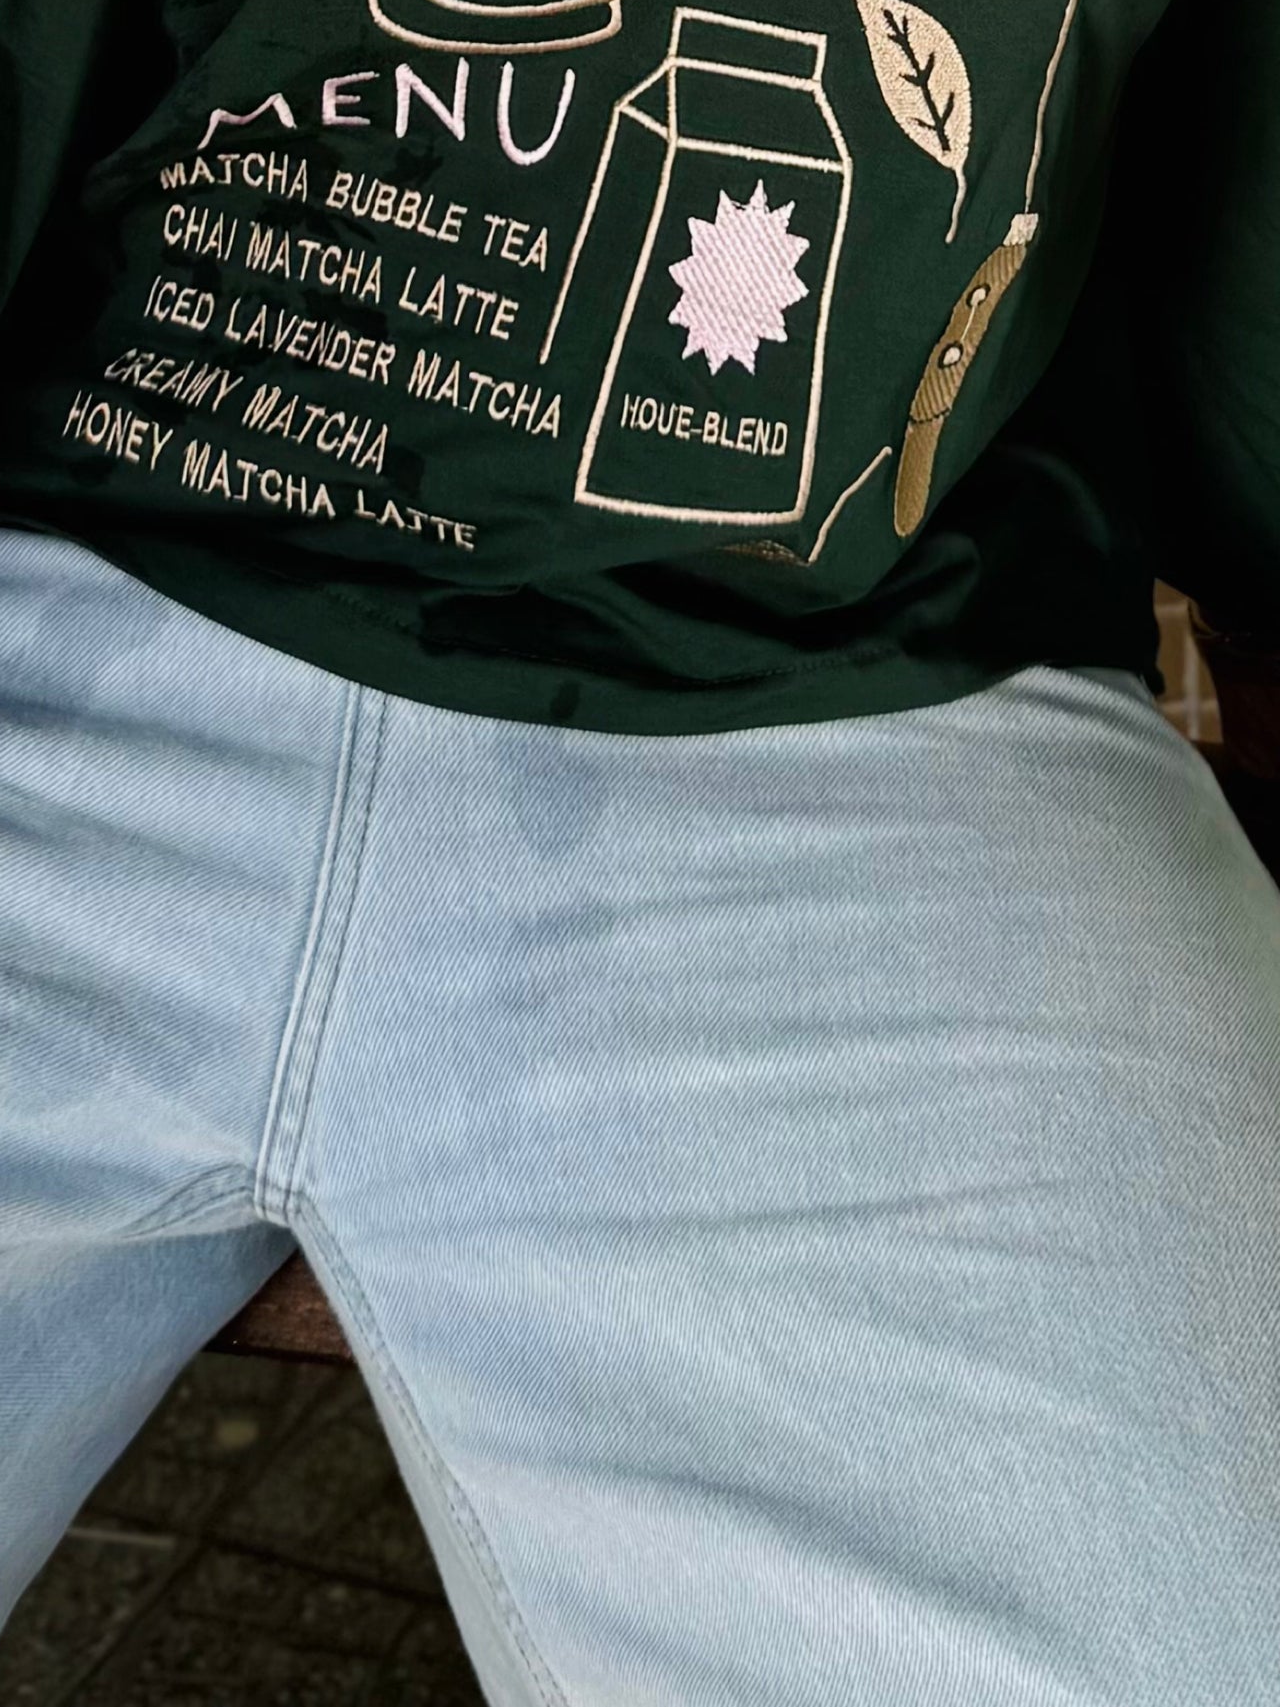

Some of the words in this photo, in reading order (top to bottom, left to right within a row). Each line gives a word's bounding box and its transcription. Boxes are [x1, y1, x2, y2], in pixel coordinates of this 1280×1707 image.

[197, 56, 576, 166] MENU
[159, 151, 309, 203] MATCHA
[325, 171, 468, 243] BUBBLE
[483, 213, 550, 273] TEA
[161, 203, 238, 263] CHAI
[245, 220, 382, 299] MATCHA
[397, 266, 521, 341] LATTE
[103, 347, 244, 413] CREAMY
[241, 384, 390, 475] MATCHA
[143, 274, 215, 334] ICED
[223, 296, 397, 386] LAVENDER
[406, 349, 563, 439] MATCHA
[61, 389, 174, 472] HONEY
[180, 439, 337, 520] MATCHA
[354, 489, 478, 552] LATTE
